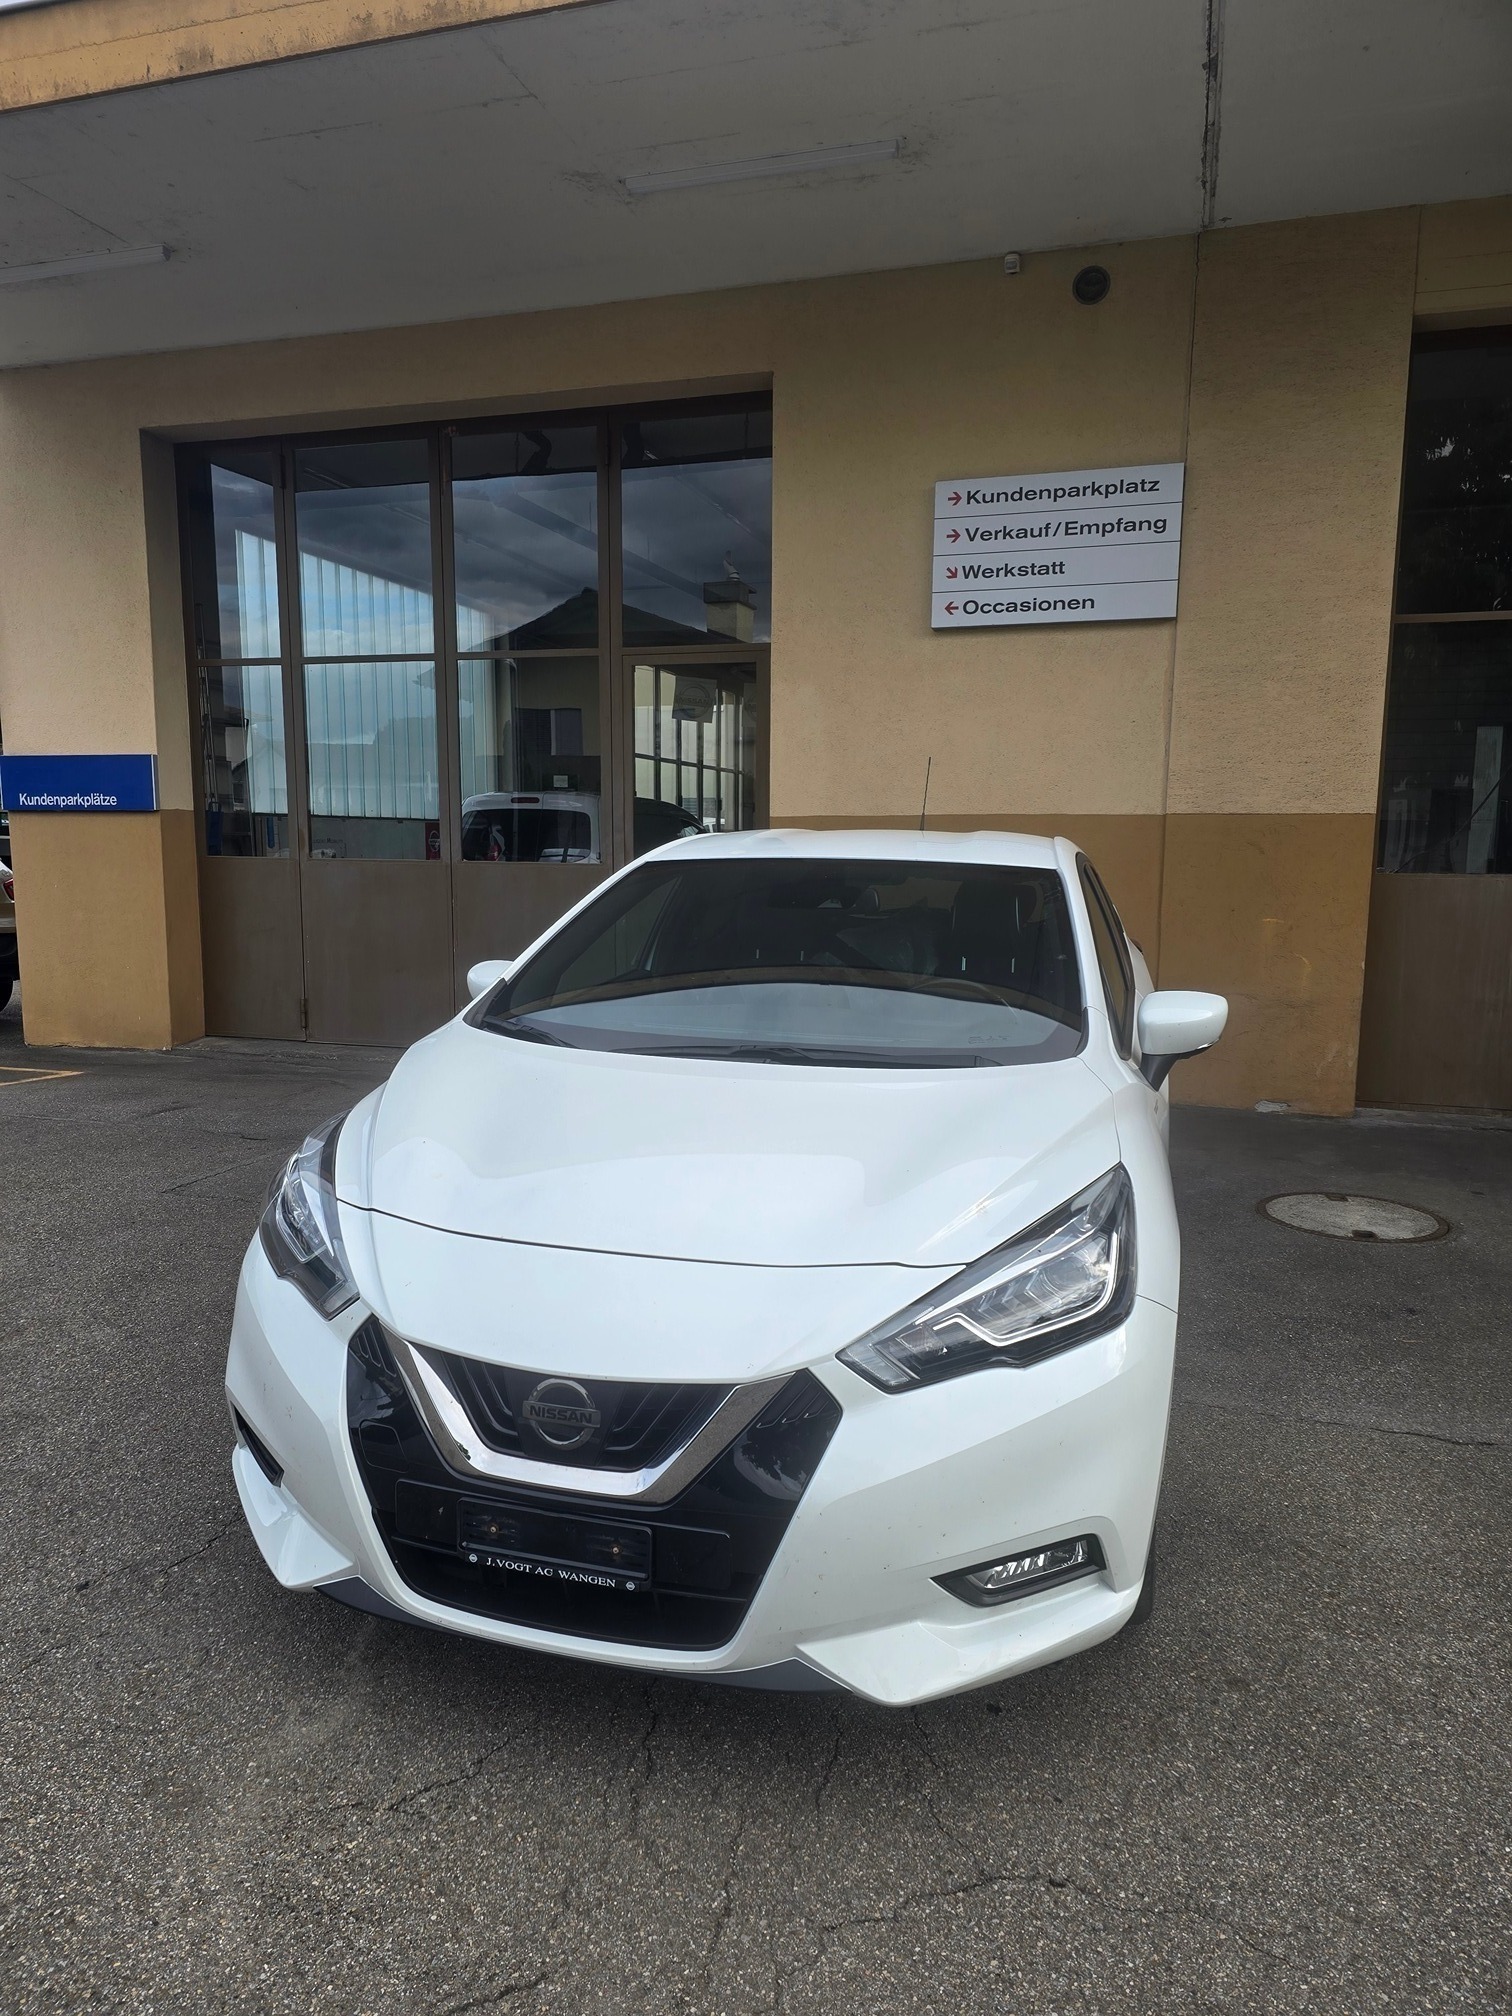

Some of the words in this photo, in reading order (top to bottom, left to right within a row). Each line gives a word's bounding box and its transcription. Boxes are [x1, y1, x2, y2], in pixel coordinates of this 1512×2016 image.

[965, 478, 1161, 506] Kundenparkplatz
[964, 517, 1168, 543] Verkauf/Empfang
[961, 560, 1066, 580] Werkstatt
[962, 597, 1095, 615] Occasionen
[18, 792, 118, 808] Kundenparkplätze
[529, 1404, 592, 1424] NISSAN
[535, 1566, 553, 1577] AG
[558, 1570, 616, 1587] WANGEN
